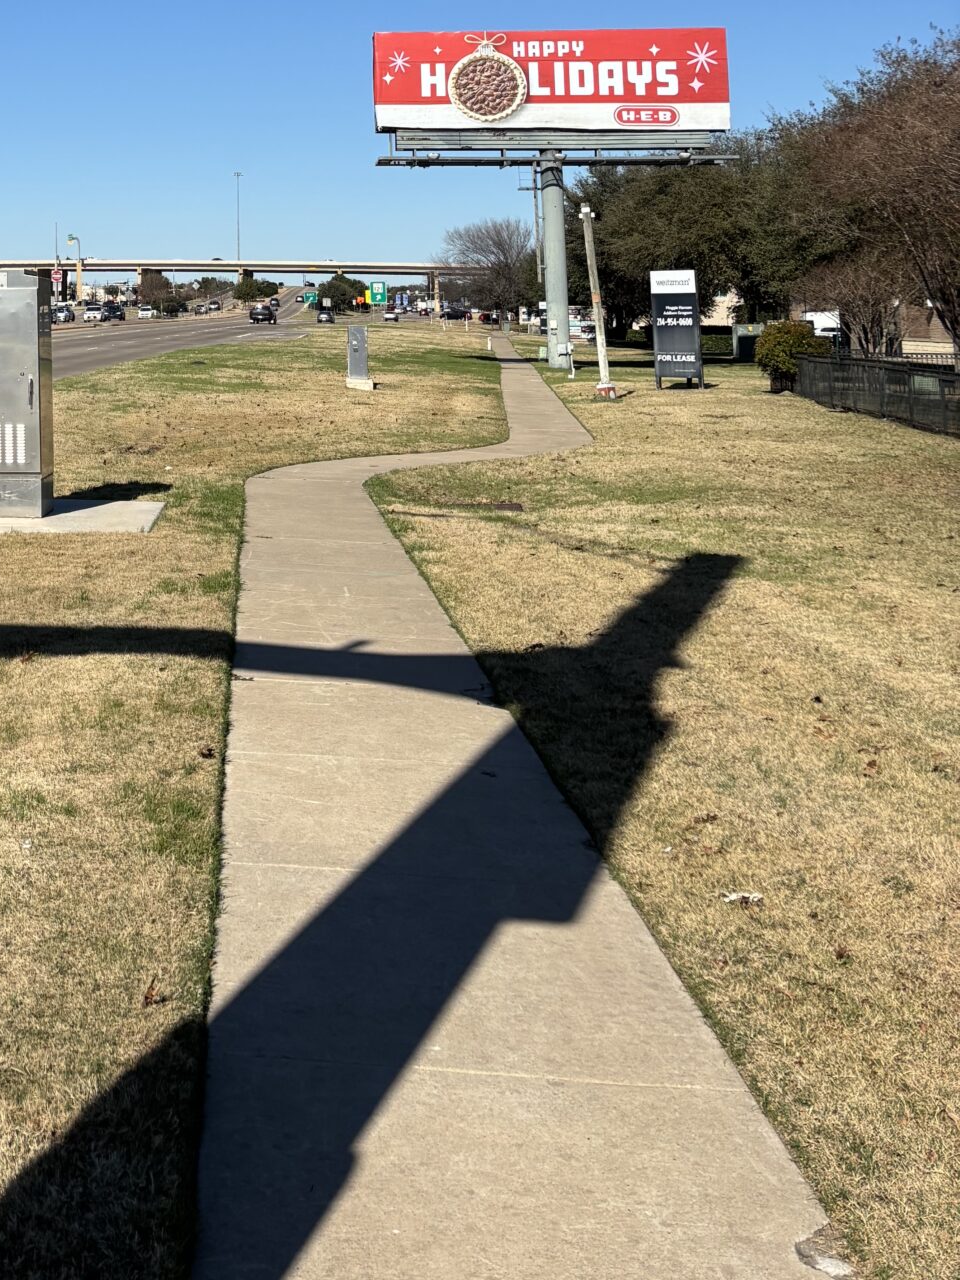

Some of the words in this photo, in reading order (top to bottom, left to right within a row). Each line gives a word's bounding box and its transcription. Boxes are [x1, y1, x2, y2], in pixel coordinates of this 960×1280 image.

[512, 40, 585, 58] HAPPY
[420, 56, 679, 111] HOLIDAYS
[621, 110, 672, 122] H-E-B
[657, 354, 672, 362] FOR
[672, 354, 696, 362] LEASE
